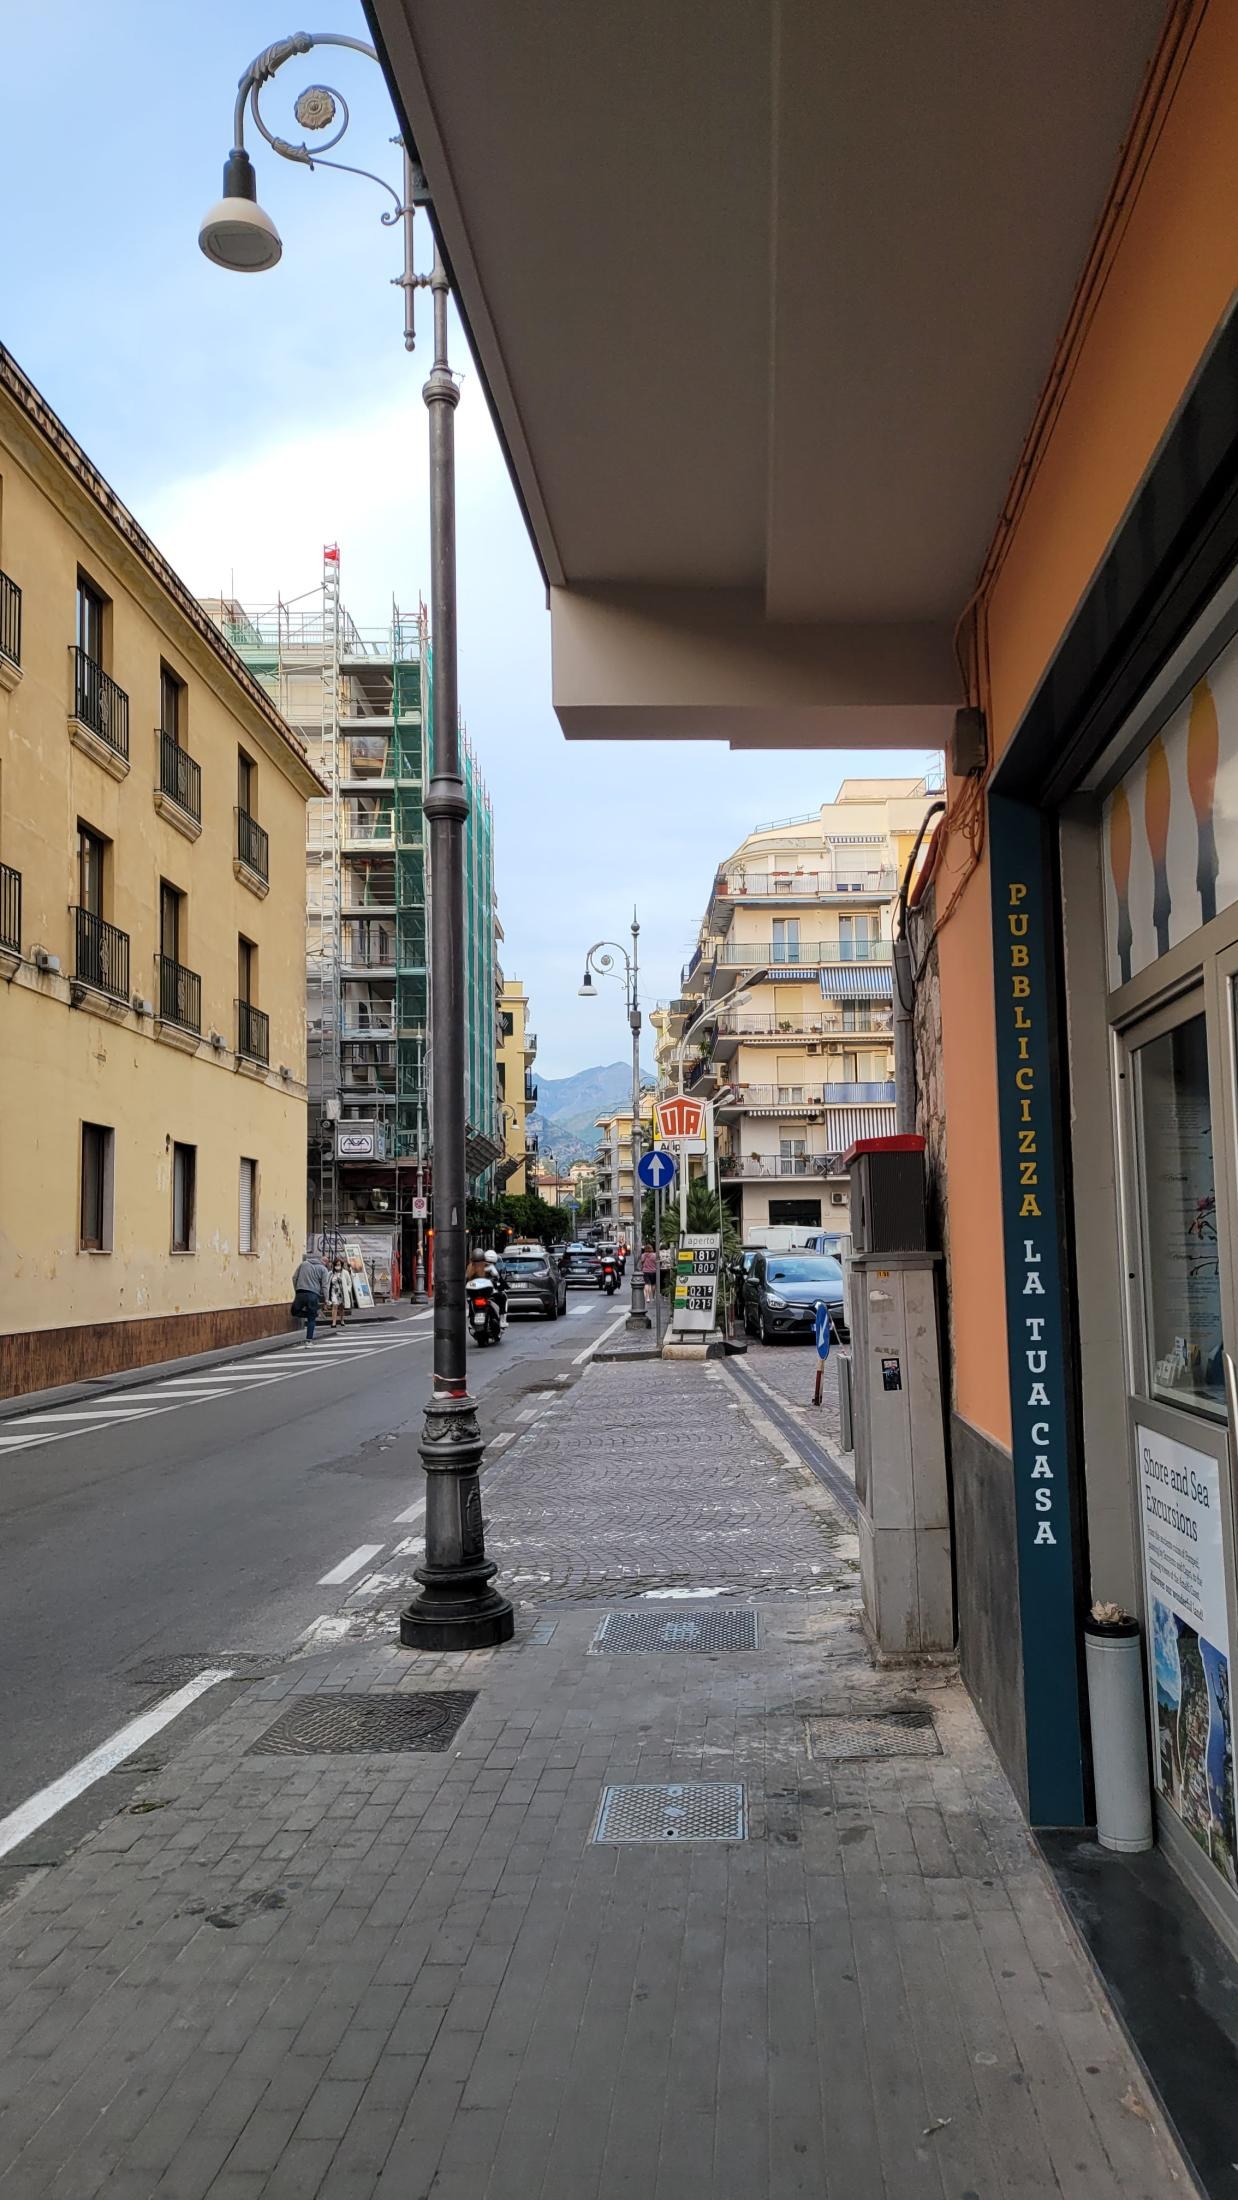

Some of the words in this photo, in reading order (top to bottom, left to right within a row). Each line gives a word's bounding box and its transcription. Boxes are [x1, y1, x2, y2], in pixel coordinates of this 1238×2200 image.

[1008, 883, 1042, 1217] PUBBLICIZZA
[660, 1098, 702, 1136] UTA
[688, 1237, 715, 1246] aperto
[1022, 1239, 1046, 1295] LA
[689, 1299, 711, 1310] 0215
[690, 1286, 713, 1297] 0215
[1143, 1447, 1169, 1486] Shore
[1171, 1466, 1189, 1497] and
[1190, 1470, 1210, 1509] Sea
[1145, 1484, 1198, 1542] Excursions
